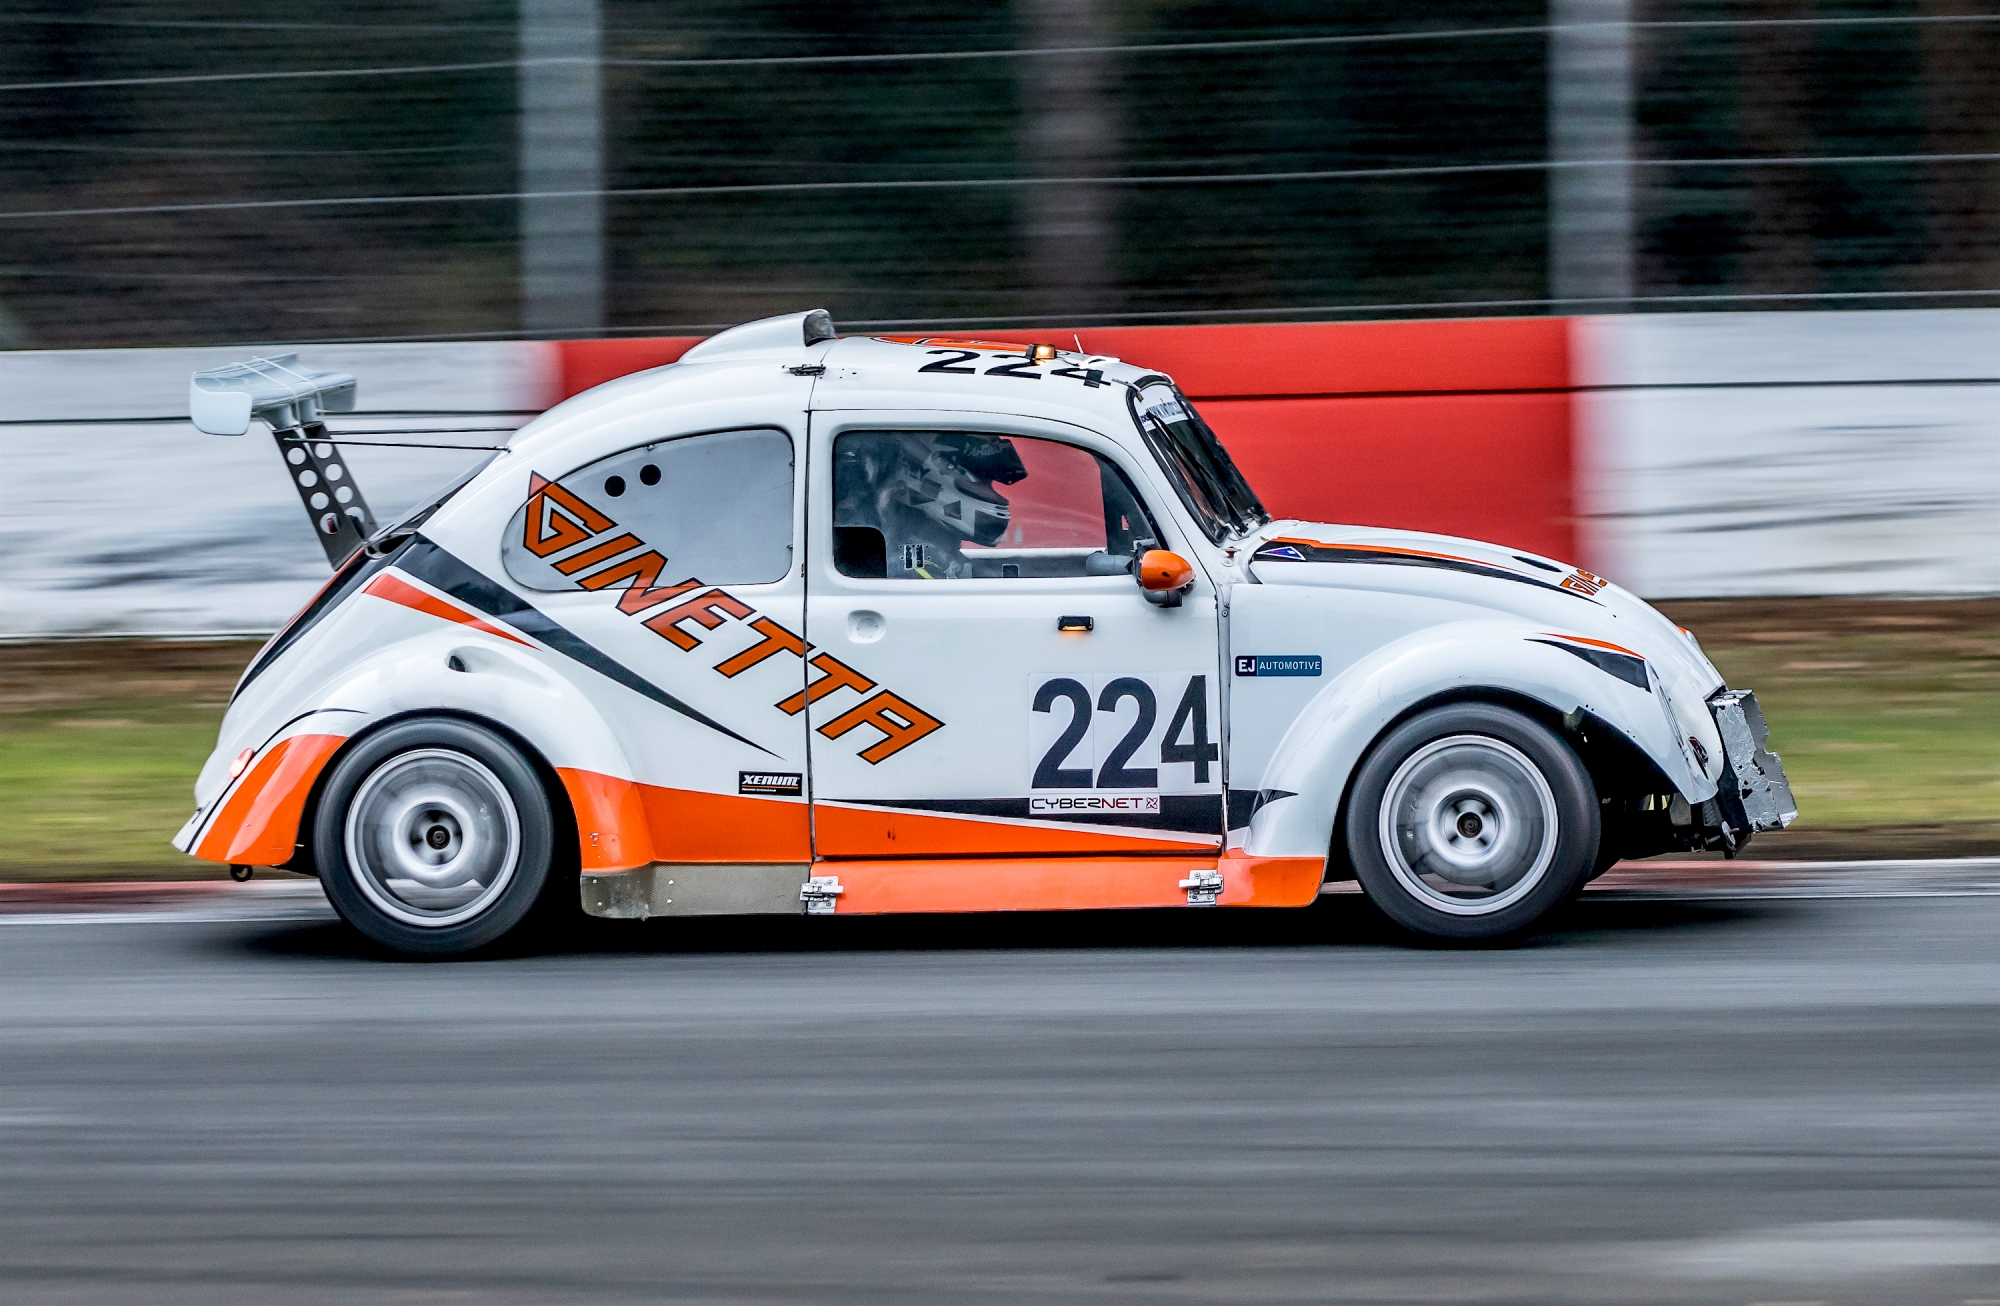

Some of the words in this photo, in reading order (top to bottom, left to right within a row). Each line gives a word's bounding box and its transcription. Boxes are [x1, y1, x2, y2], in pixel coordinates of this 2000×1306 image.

[917, 349, 1111, 388] 224
[522, 470, 947, 766] GINETTA
[1238, 659, 1256, 672] EJ
[1259, 661, 1321, 670] AUTOMOTIVE
[1031, 674, 1219, 790] 224
[741, 774, 799, 786] XENUM
[1031, 797, 1143, 809] CYBERNET
